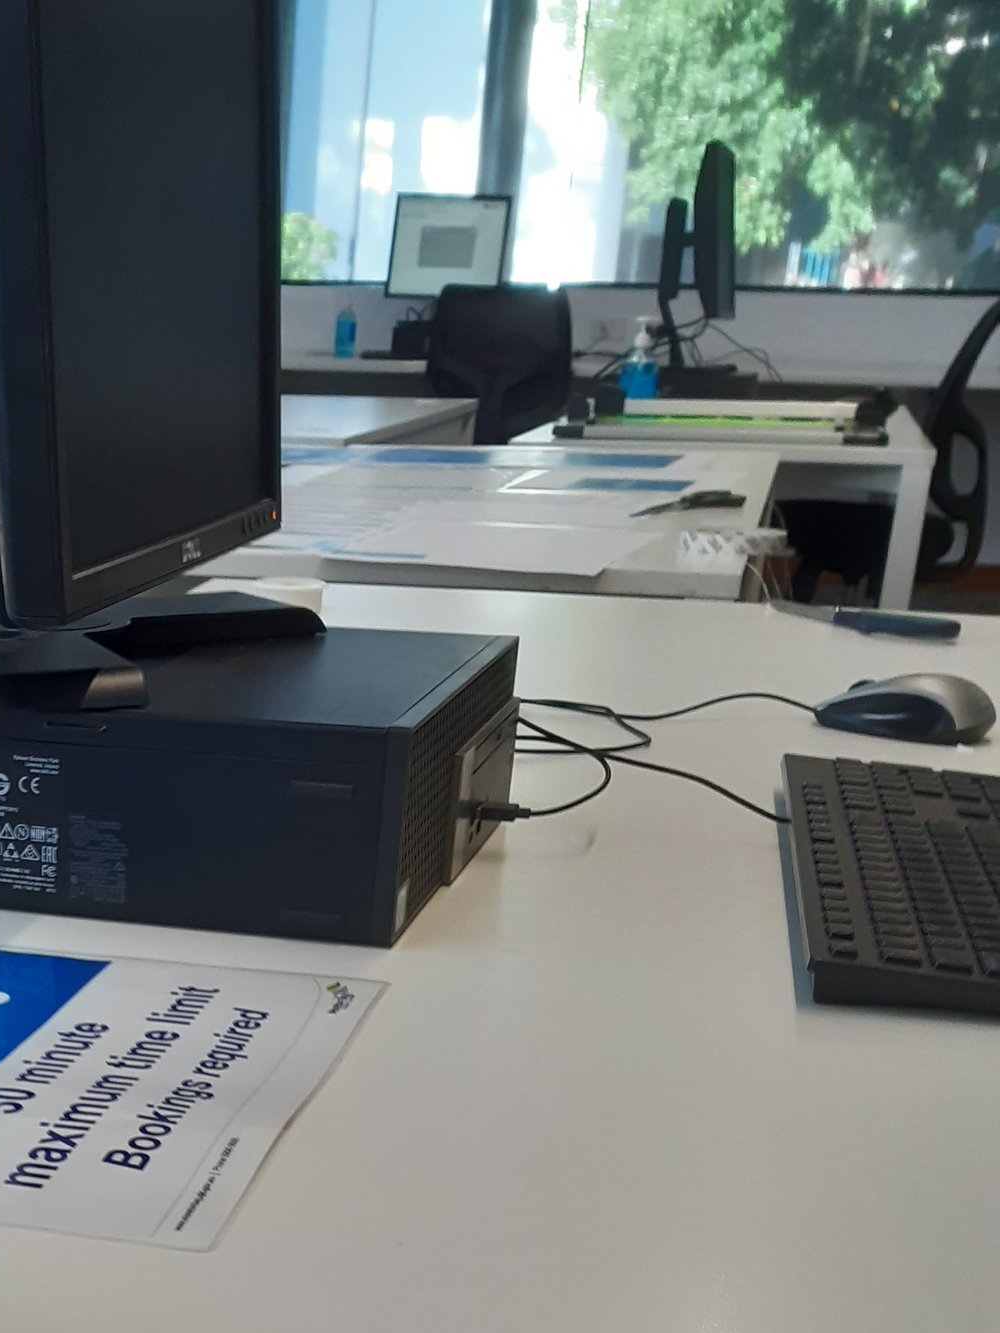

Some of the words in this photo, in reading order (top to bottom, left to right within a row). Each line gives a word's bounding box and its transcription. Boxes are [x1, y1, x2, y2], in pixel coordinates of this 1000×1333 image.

[3, 1071, 141, 1189] maximum
[106, 1029, 181, 1070] time
[145, 985, 221, 1026] limit
[14, 1021, 110, 1085] minute
[101, 1078, 215, 1171] Bookings
[192, 1006, 270, 1078] required
